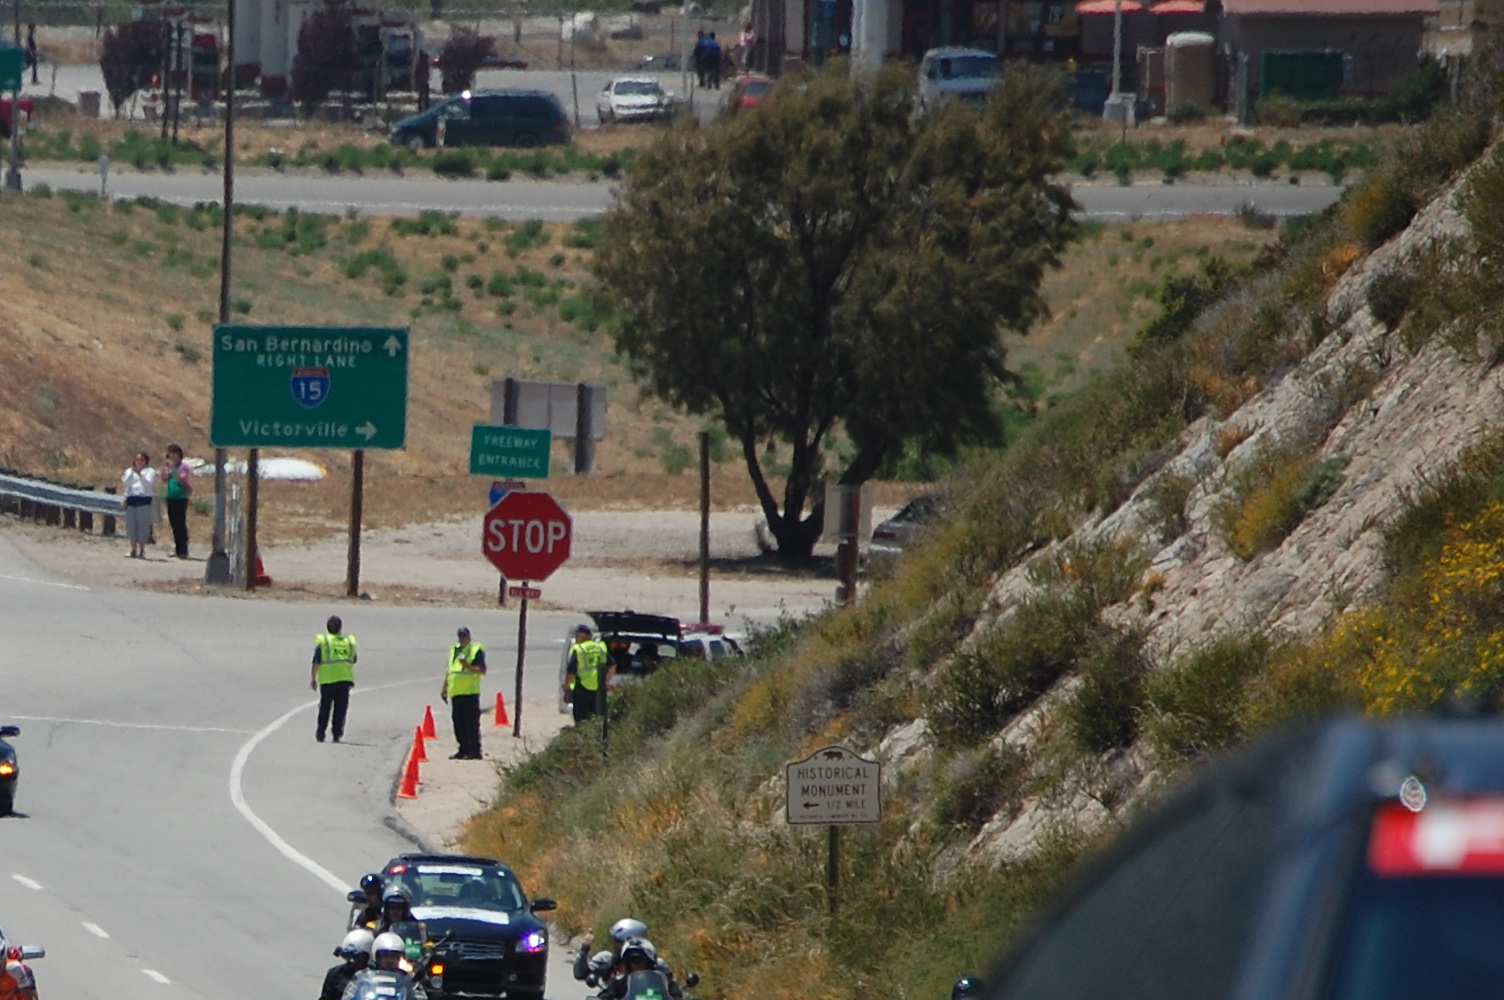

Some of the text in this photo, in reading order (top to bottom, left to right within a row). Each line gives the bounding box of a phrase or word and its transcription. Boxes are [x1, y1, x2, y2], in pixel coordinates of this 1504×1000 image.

[221, 335, 373, 353] San Bernardino
[257, 355, 356, 368] RIGHT LANE
[299, 381, 322, 400] 15
[239, 420, 348, 438] Victorville
[483, 435, 538, 450] FREEWAY
[478, 453, 541, 469] ENTRANCE
[488, 519, 566, 553] STOP
[798, 767, 869, 780] HISTORICAL
[801, 784, 866, 797] MONUMENT
[827, 799, 866, 809] 1/2 MILE
